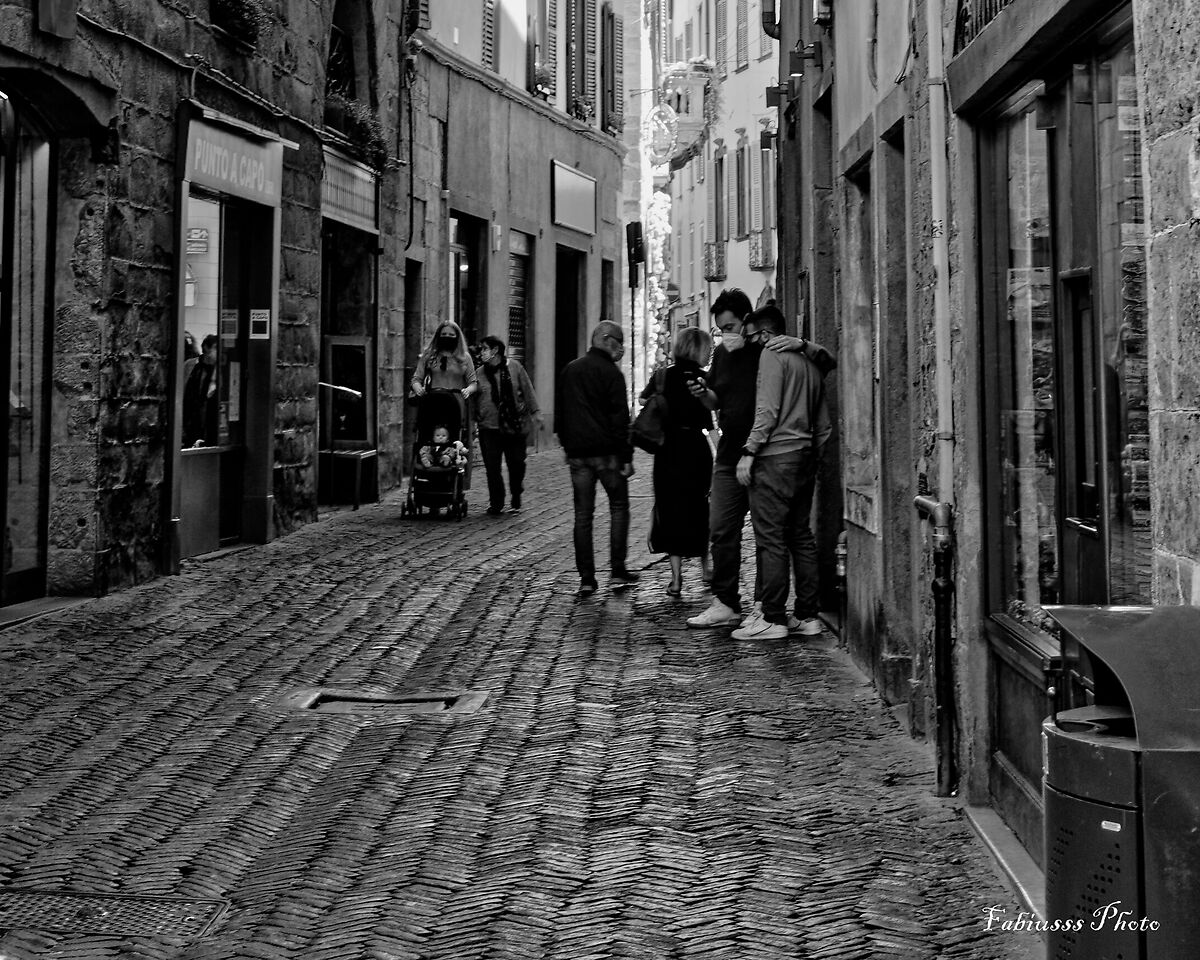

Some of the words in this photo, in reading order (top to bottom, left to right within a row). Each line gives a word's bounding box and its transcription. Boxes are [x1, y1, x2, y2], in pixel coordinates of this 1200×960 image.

[193, 138, 229, 180] PUNTO
[230, 152, 238, 184] A
[239, 155, 265, 192] CAPO
